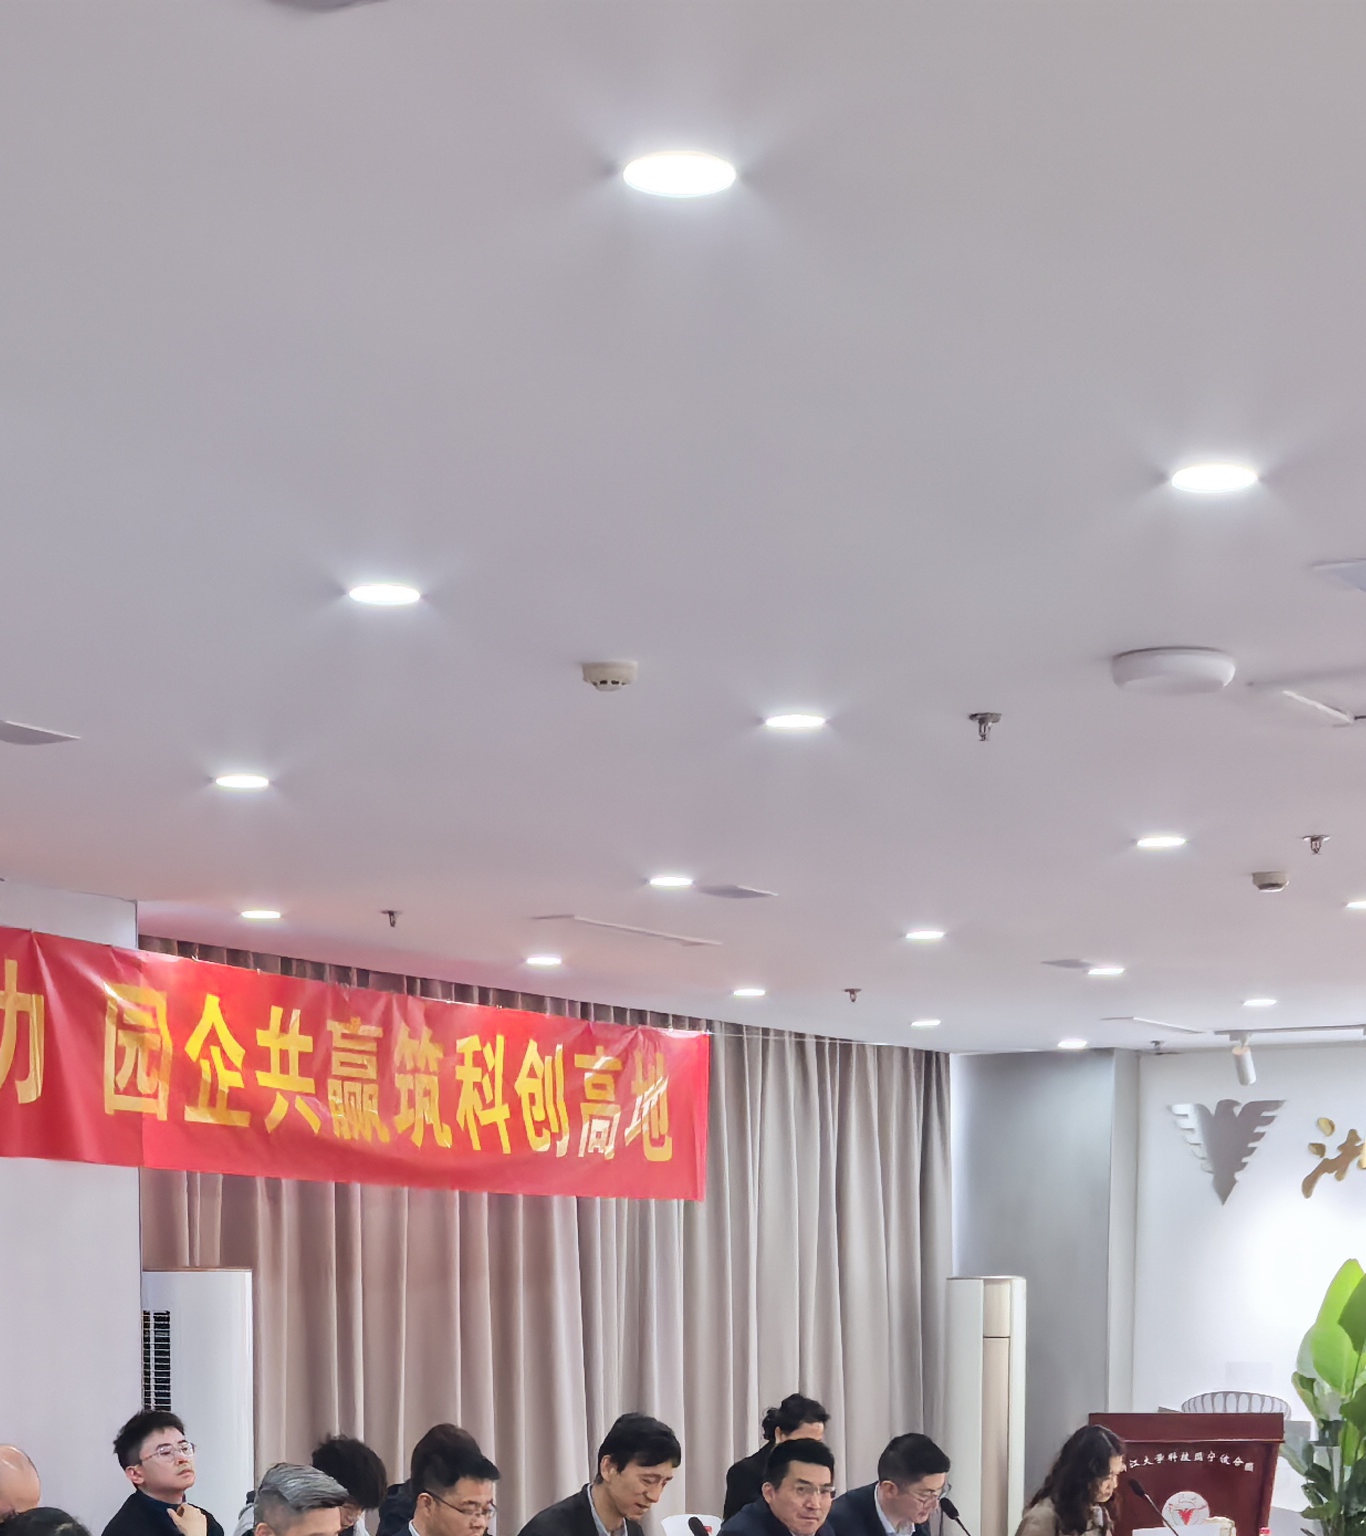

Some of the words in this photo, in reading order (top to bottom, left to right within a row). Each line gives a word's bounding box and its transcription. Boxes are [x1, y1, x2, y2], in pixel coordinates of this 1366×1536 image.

[102, 980, 674, 1163] 园企共赢筑科创高地
